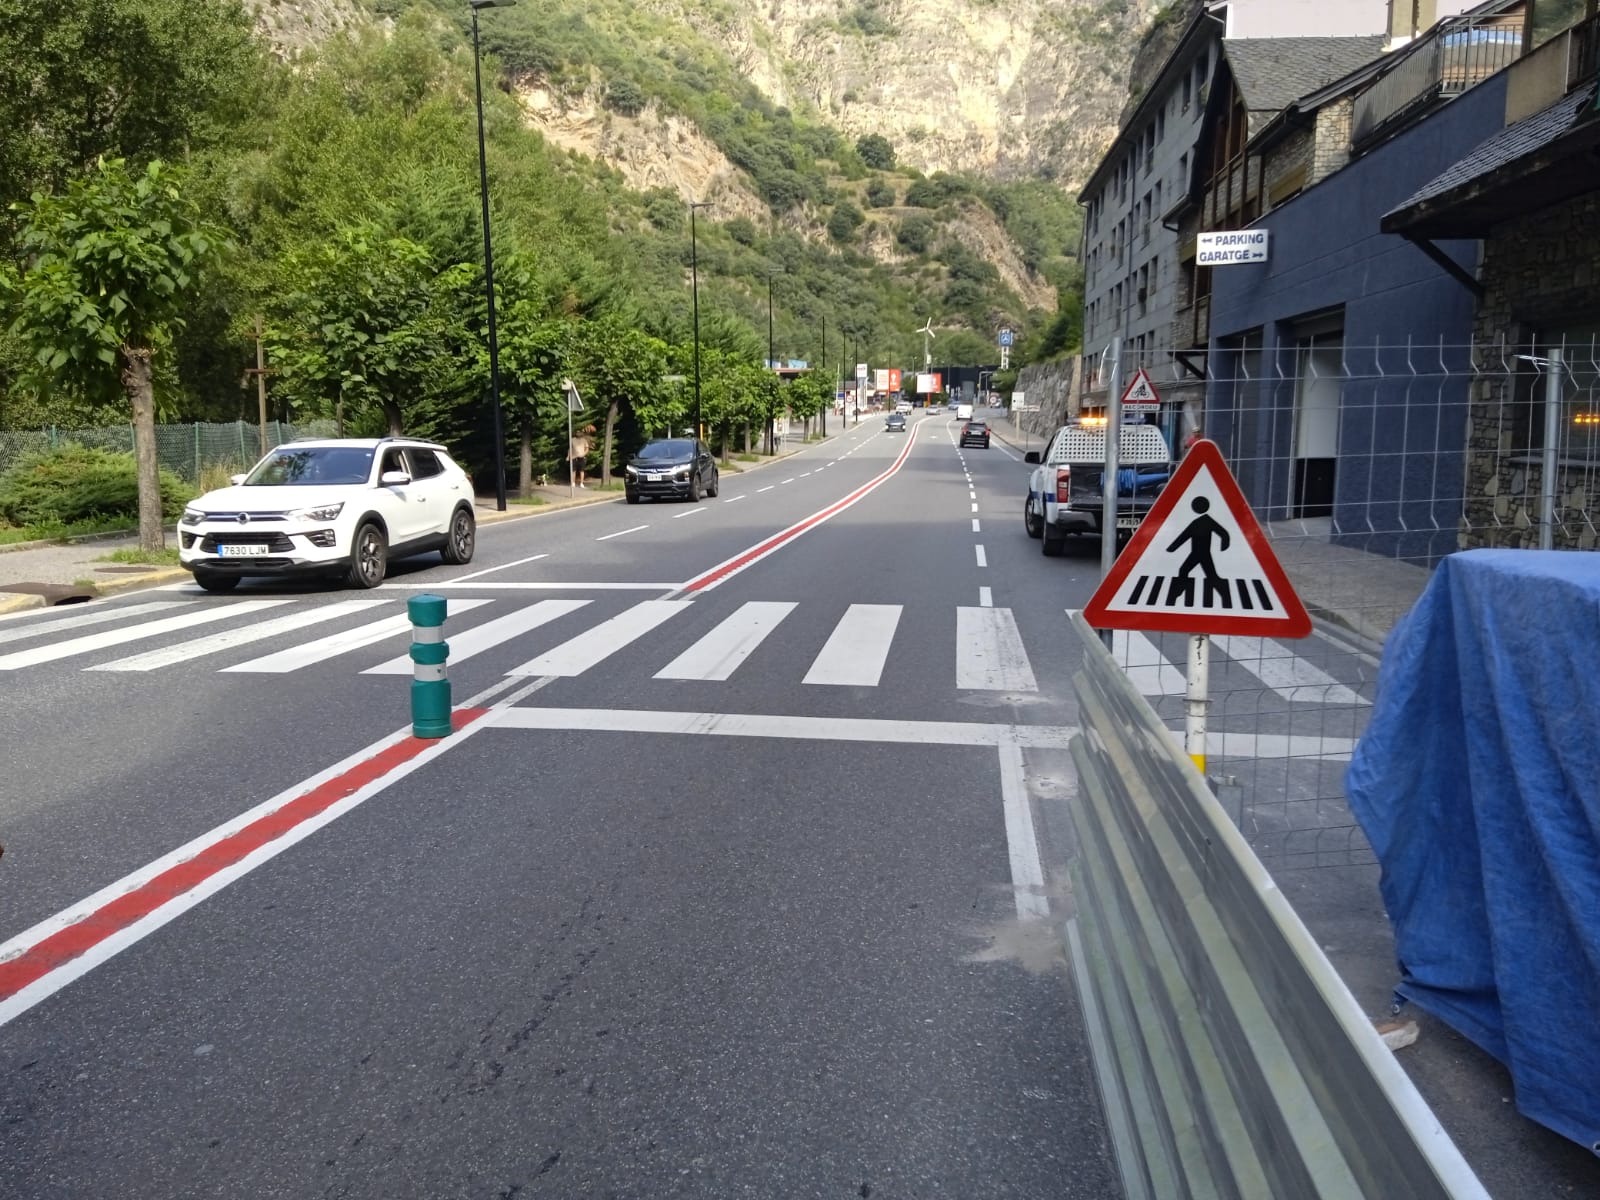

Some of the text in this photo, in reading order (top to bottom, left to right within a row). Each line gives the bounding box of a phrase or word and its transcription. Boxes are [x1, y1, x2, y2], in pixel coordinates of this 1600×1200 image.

[1215, 233, 1264, 246] PARKING
[1199, 249, 1250, 262] GARATGE
[223, 546, 267, 555] 7630 LJM
